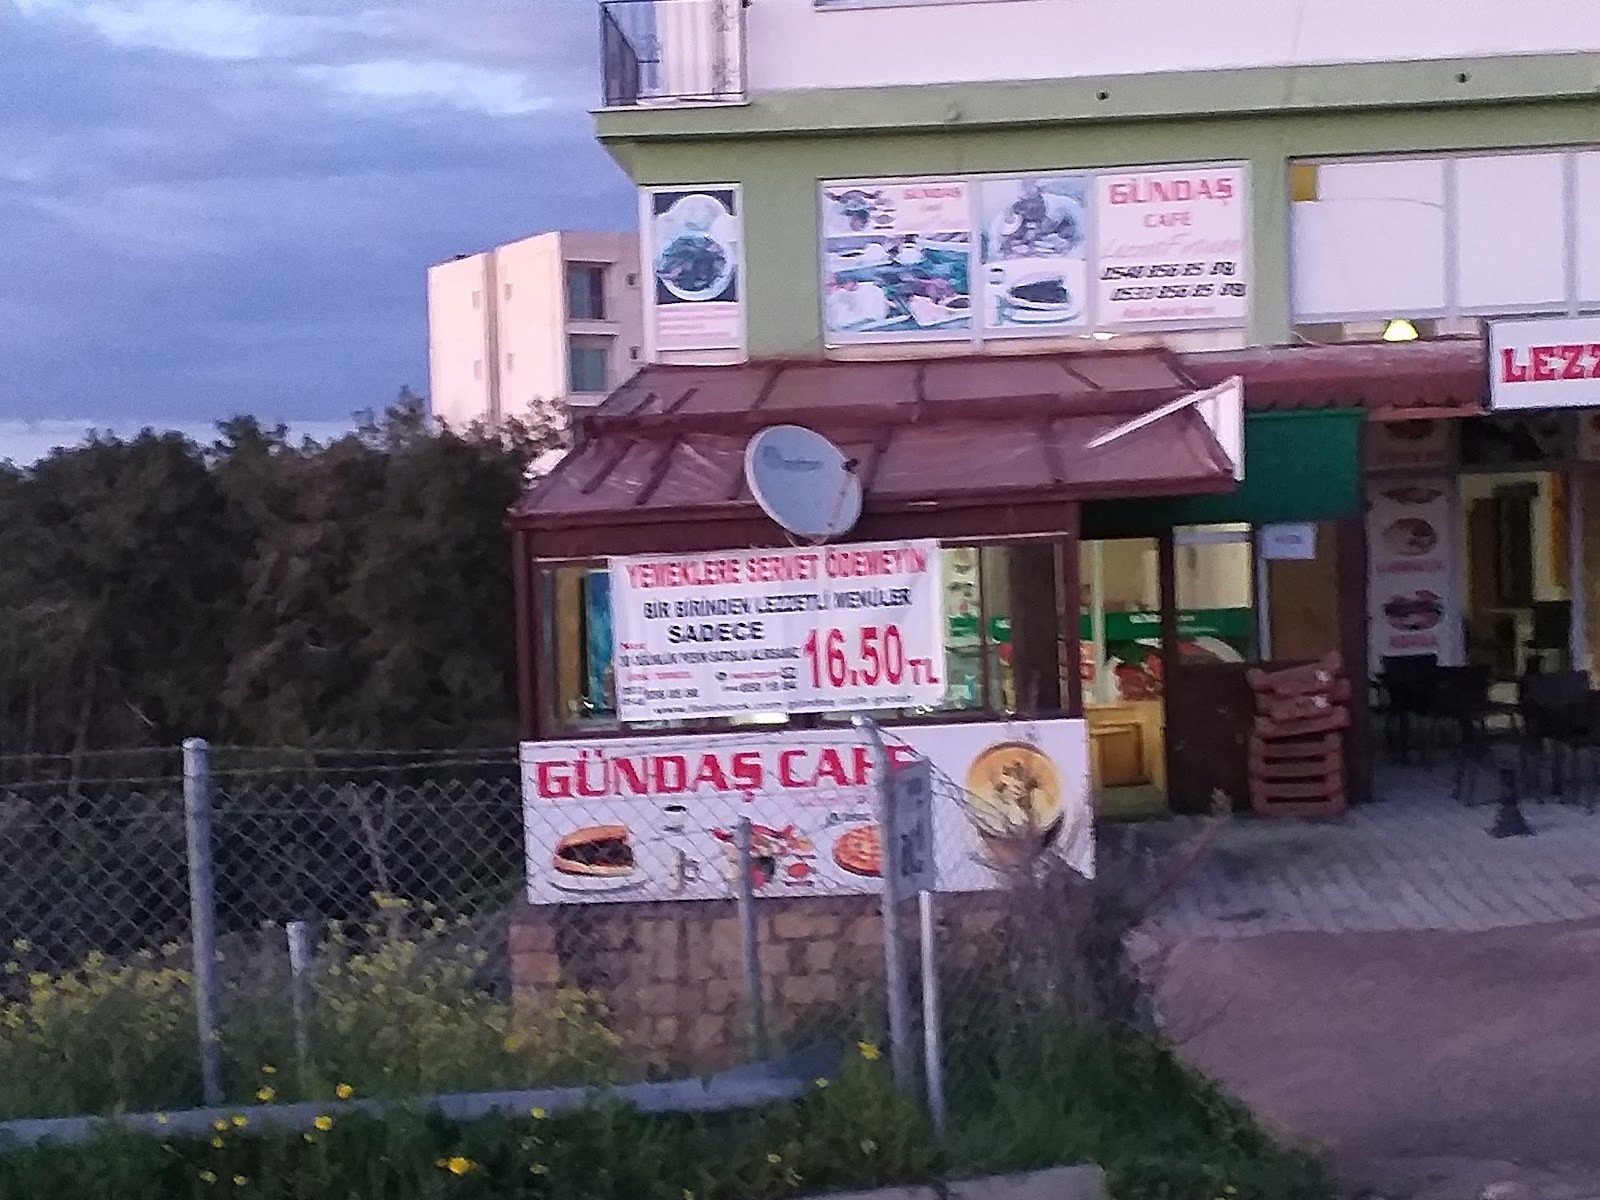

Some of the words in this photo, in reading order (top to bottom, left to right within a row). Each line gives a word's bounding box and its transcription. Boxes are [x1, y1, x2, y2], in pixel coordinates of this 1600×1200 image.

[1108, 178, 1234, 206] GÜNDAŞ
[1143, 211, 1192, 228] CAFE
[667, 620, 765, 645] SADECE
[802, 624, 904, 689] 16.50
[906, 656, 940, 686] TL
[536, 748, 764, 804] GÜNDAŞ
